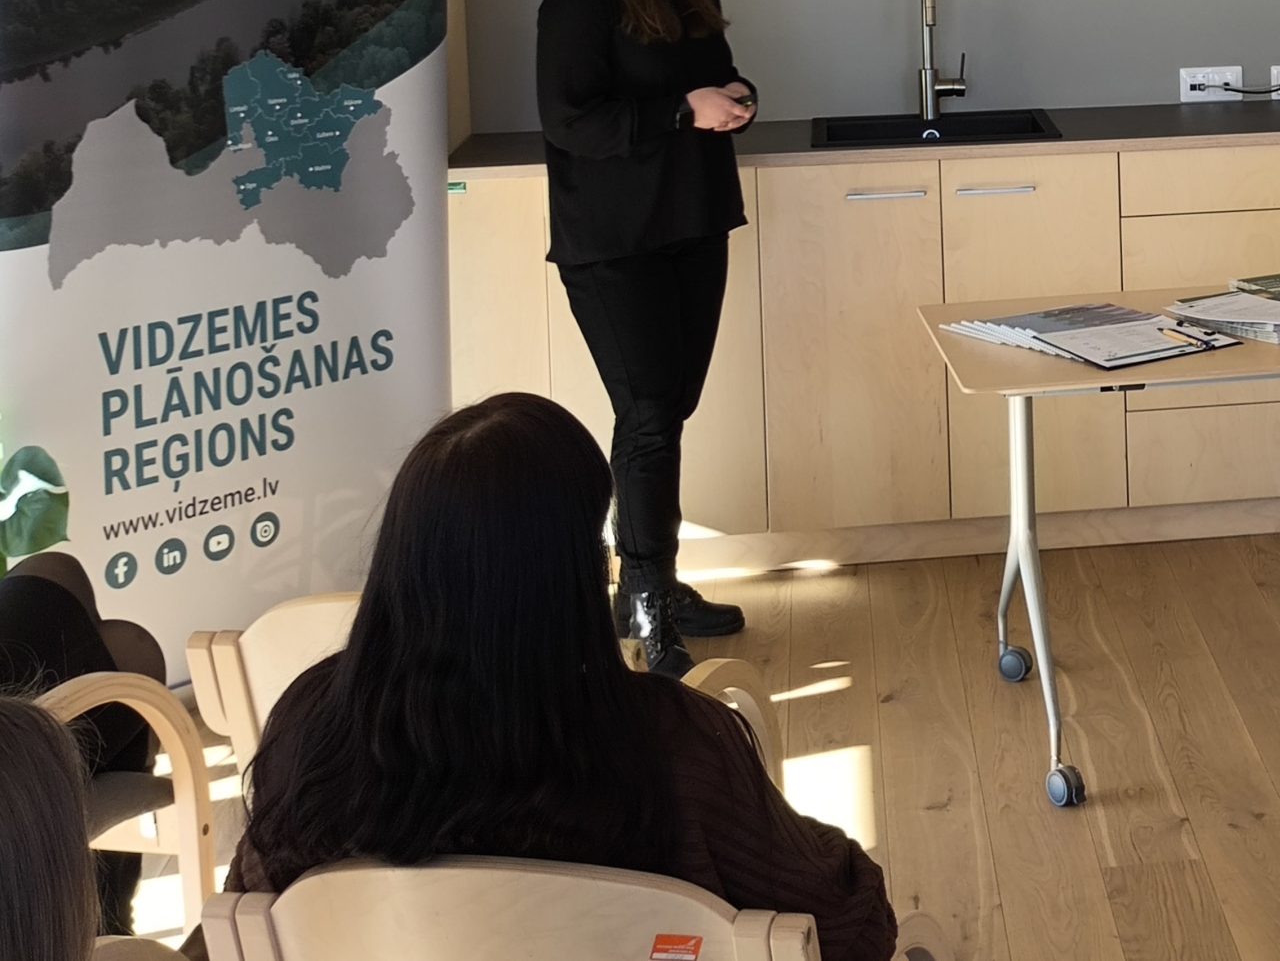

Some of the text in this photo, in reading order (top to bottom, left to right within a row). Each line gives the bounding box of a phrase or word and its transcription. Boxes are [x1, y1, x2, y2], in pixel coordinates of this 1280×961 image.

[98, 290, 320, 376] VIDZEMES
[101, 328, 394, 437] PLĀNOŠANAS
[104, 407, 295, 496] REĢIONS
[102, 477, 280, 541] www.vidzeme.lv
[162, 547, 181, 567] in
